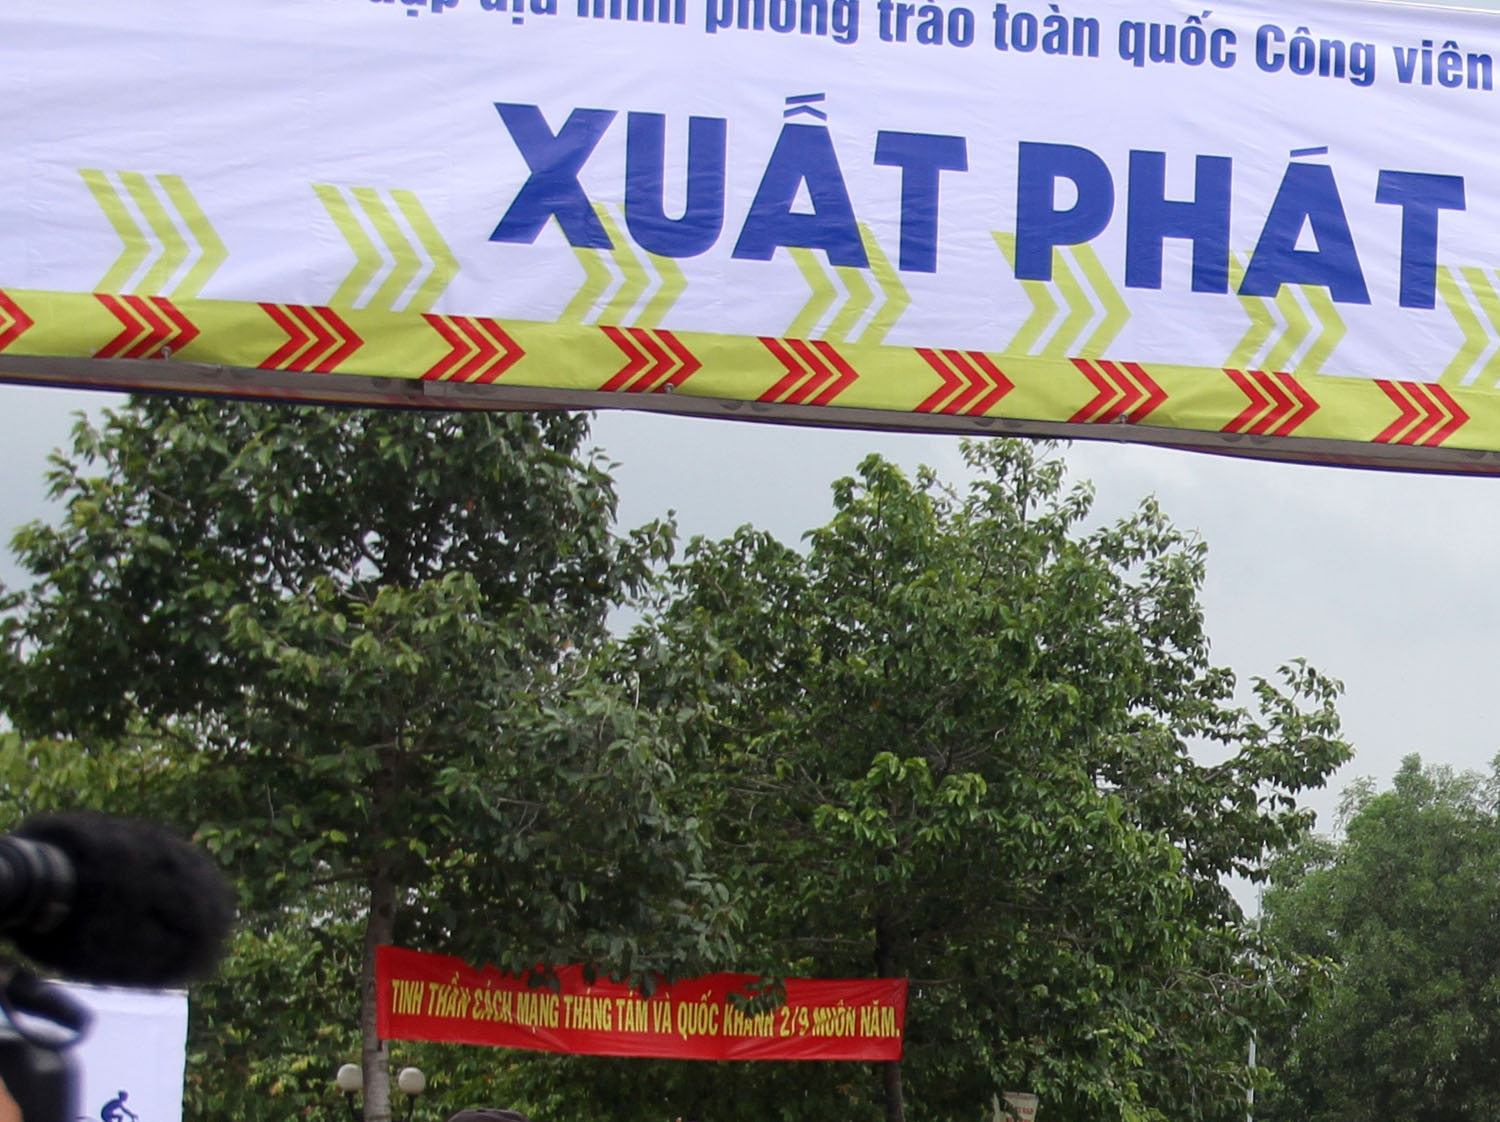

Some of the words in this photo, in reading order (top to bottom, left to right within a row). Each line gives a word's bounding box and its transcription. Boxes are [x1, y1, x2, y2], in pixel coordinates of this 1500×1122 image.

[877, 0, 974, 48] trào
[993, 3, 1099, 57] toàn
[1119, 11, 1236, 68] quốc
[1256, 25, 1375, 87] Công
[1394, 39, 1492, 91] viên
[488, 93, 968, 273] XUẤT
[1014, 141, 1466, 309] PHÁT
[392, 980, 424, 1015] TINH
[428, 971, 470, 1018] THẦN
[472, 980, 513, 1023] CÁCH
[517, 990, 559, 1034] MẠNG
[564, 988, 612, 1031] THÁNG
[616, 990, 648, 1032] TÁM
[653, 992, 672, 1033] VÀ
[677, 990, 719, 1040] QUỐC
[779, 1006, 810, 1037] 2/9
[812, 1000, 856, 1037] MUÔN
[860, 1000, 900, 1037] NĂM.
